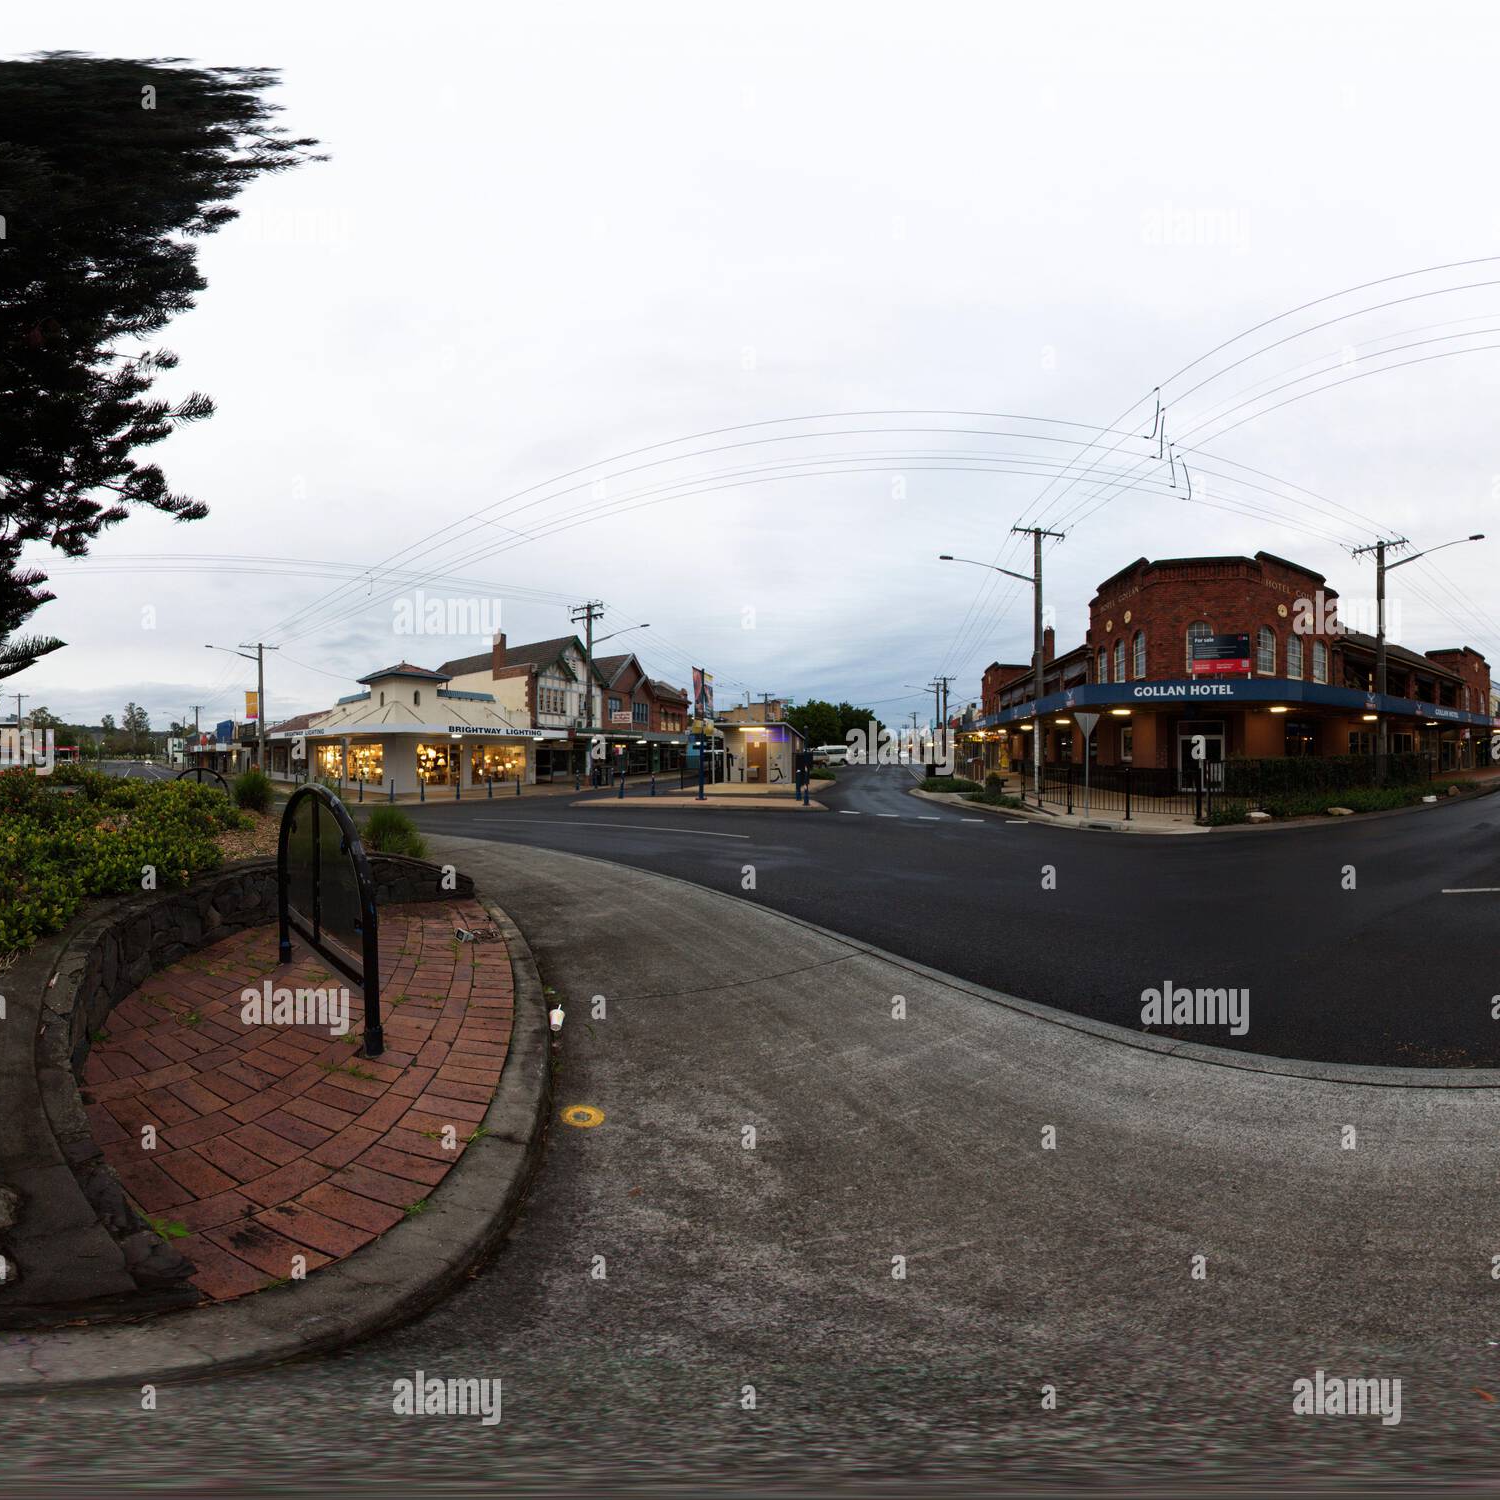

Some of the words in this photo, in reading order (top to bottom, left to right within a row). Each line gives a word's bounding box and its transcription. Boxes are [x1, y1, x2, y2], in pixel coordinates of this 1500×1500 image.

[1265, 578, 1291, 594] HOTEL
[1134, 685, 1186, 697] GOLLAN
[1190, 684, 1234, 696] HOTEL
[448, 725, 502, 735] BRIGHTWAY
